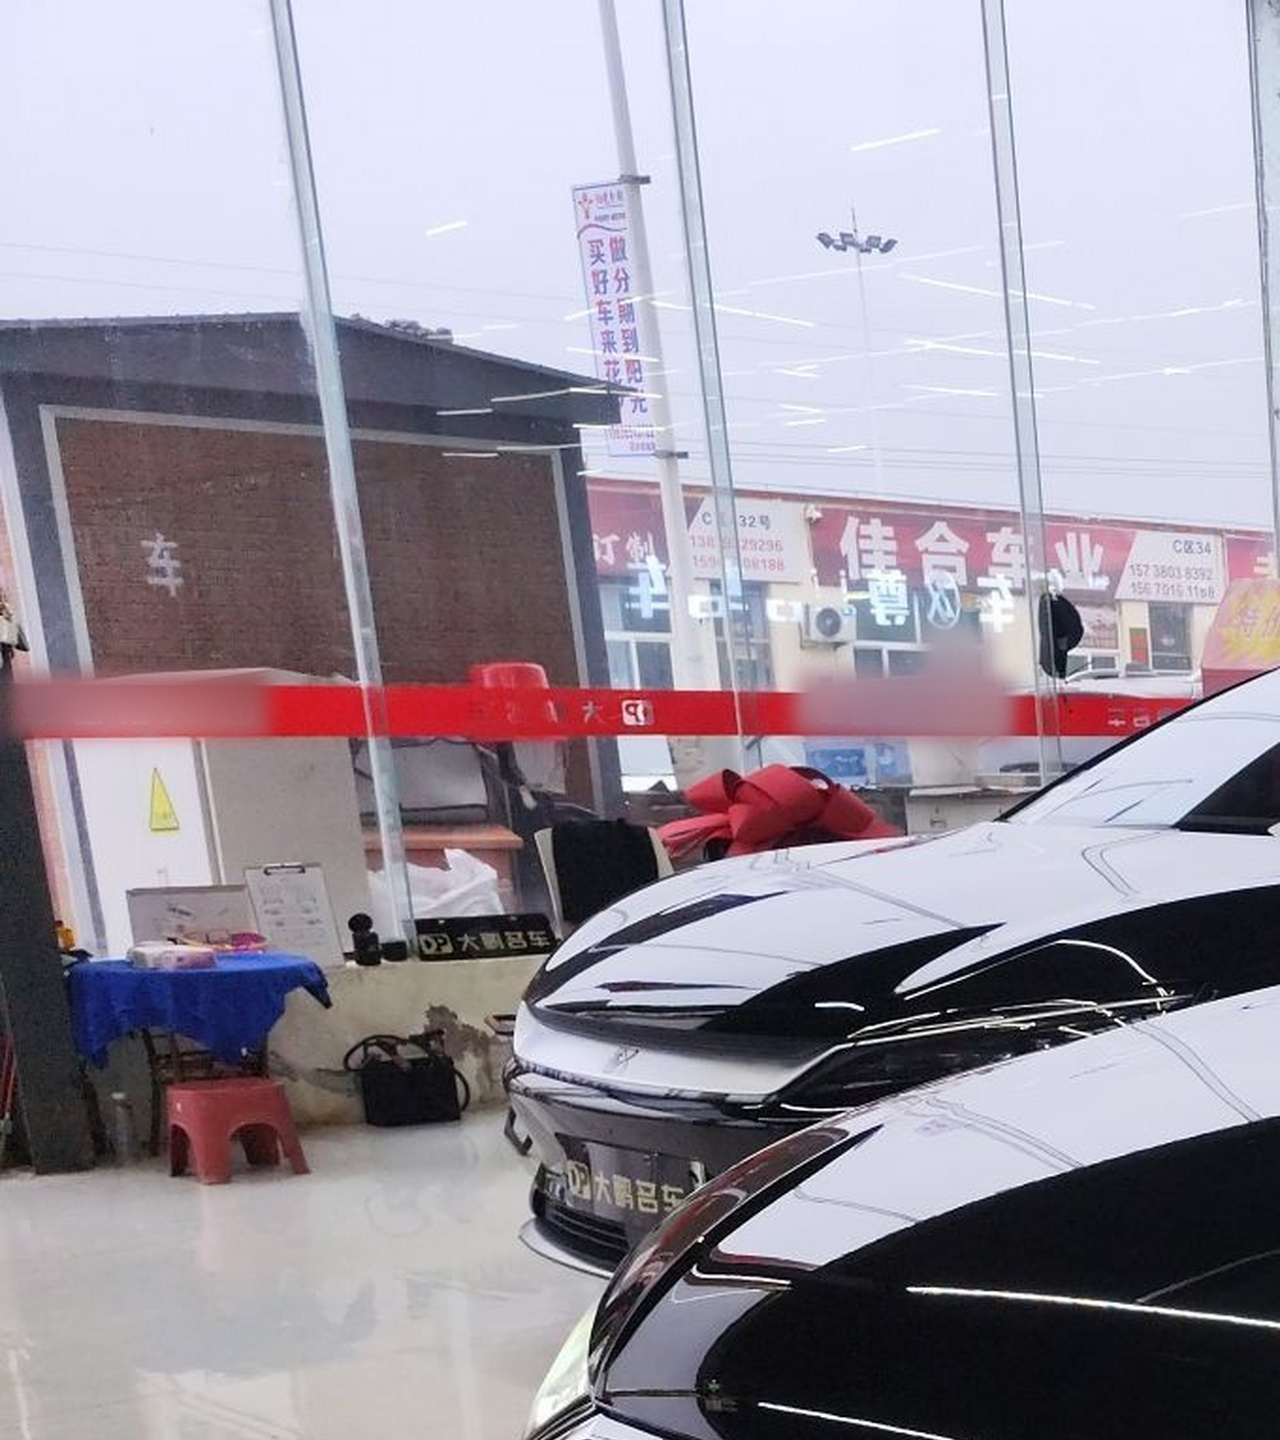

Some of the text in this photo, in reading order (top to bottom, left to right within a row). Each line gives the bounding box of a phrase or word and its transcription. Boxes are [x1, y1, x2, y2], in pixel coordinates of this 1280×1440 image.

[587, 239, 622, 407] 买好车来花
[840, 516, 1104, 590] 佳合车业
